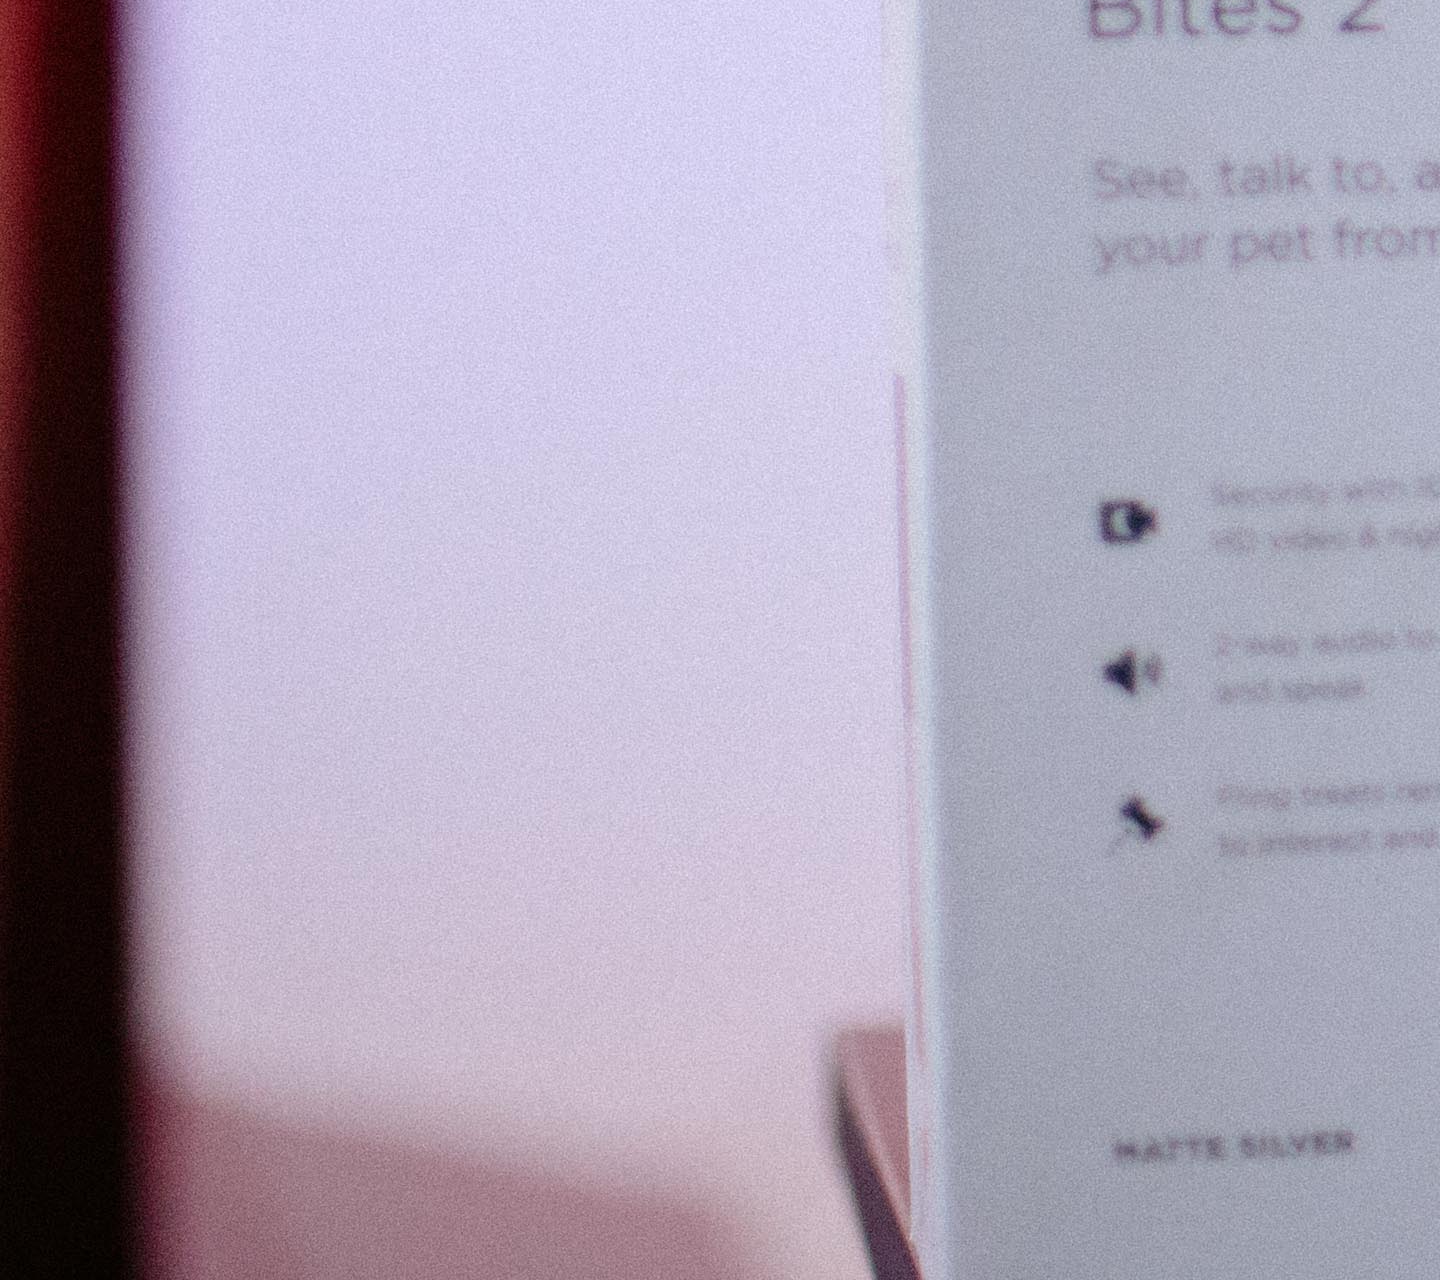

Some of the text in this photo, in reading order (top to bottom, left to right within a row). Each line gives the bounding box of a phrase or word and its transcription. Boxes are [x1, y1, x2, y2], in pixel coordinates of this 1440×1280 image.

[1093, 157, 1198, 204] See,
[1218, 151, 1312, 198] talk
[1093, 226, 1210, 276] your
[1230, 224, 1315, 270] pet
